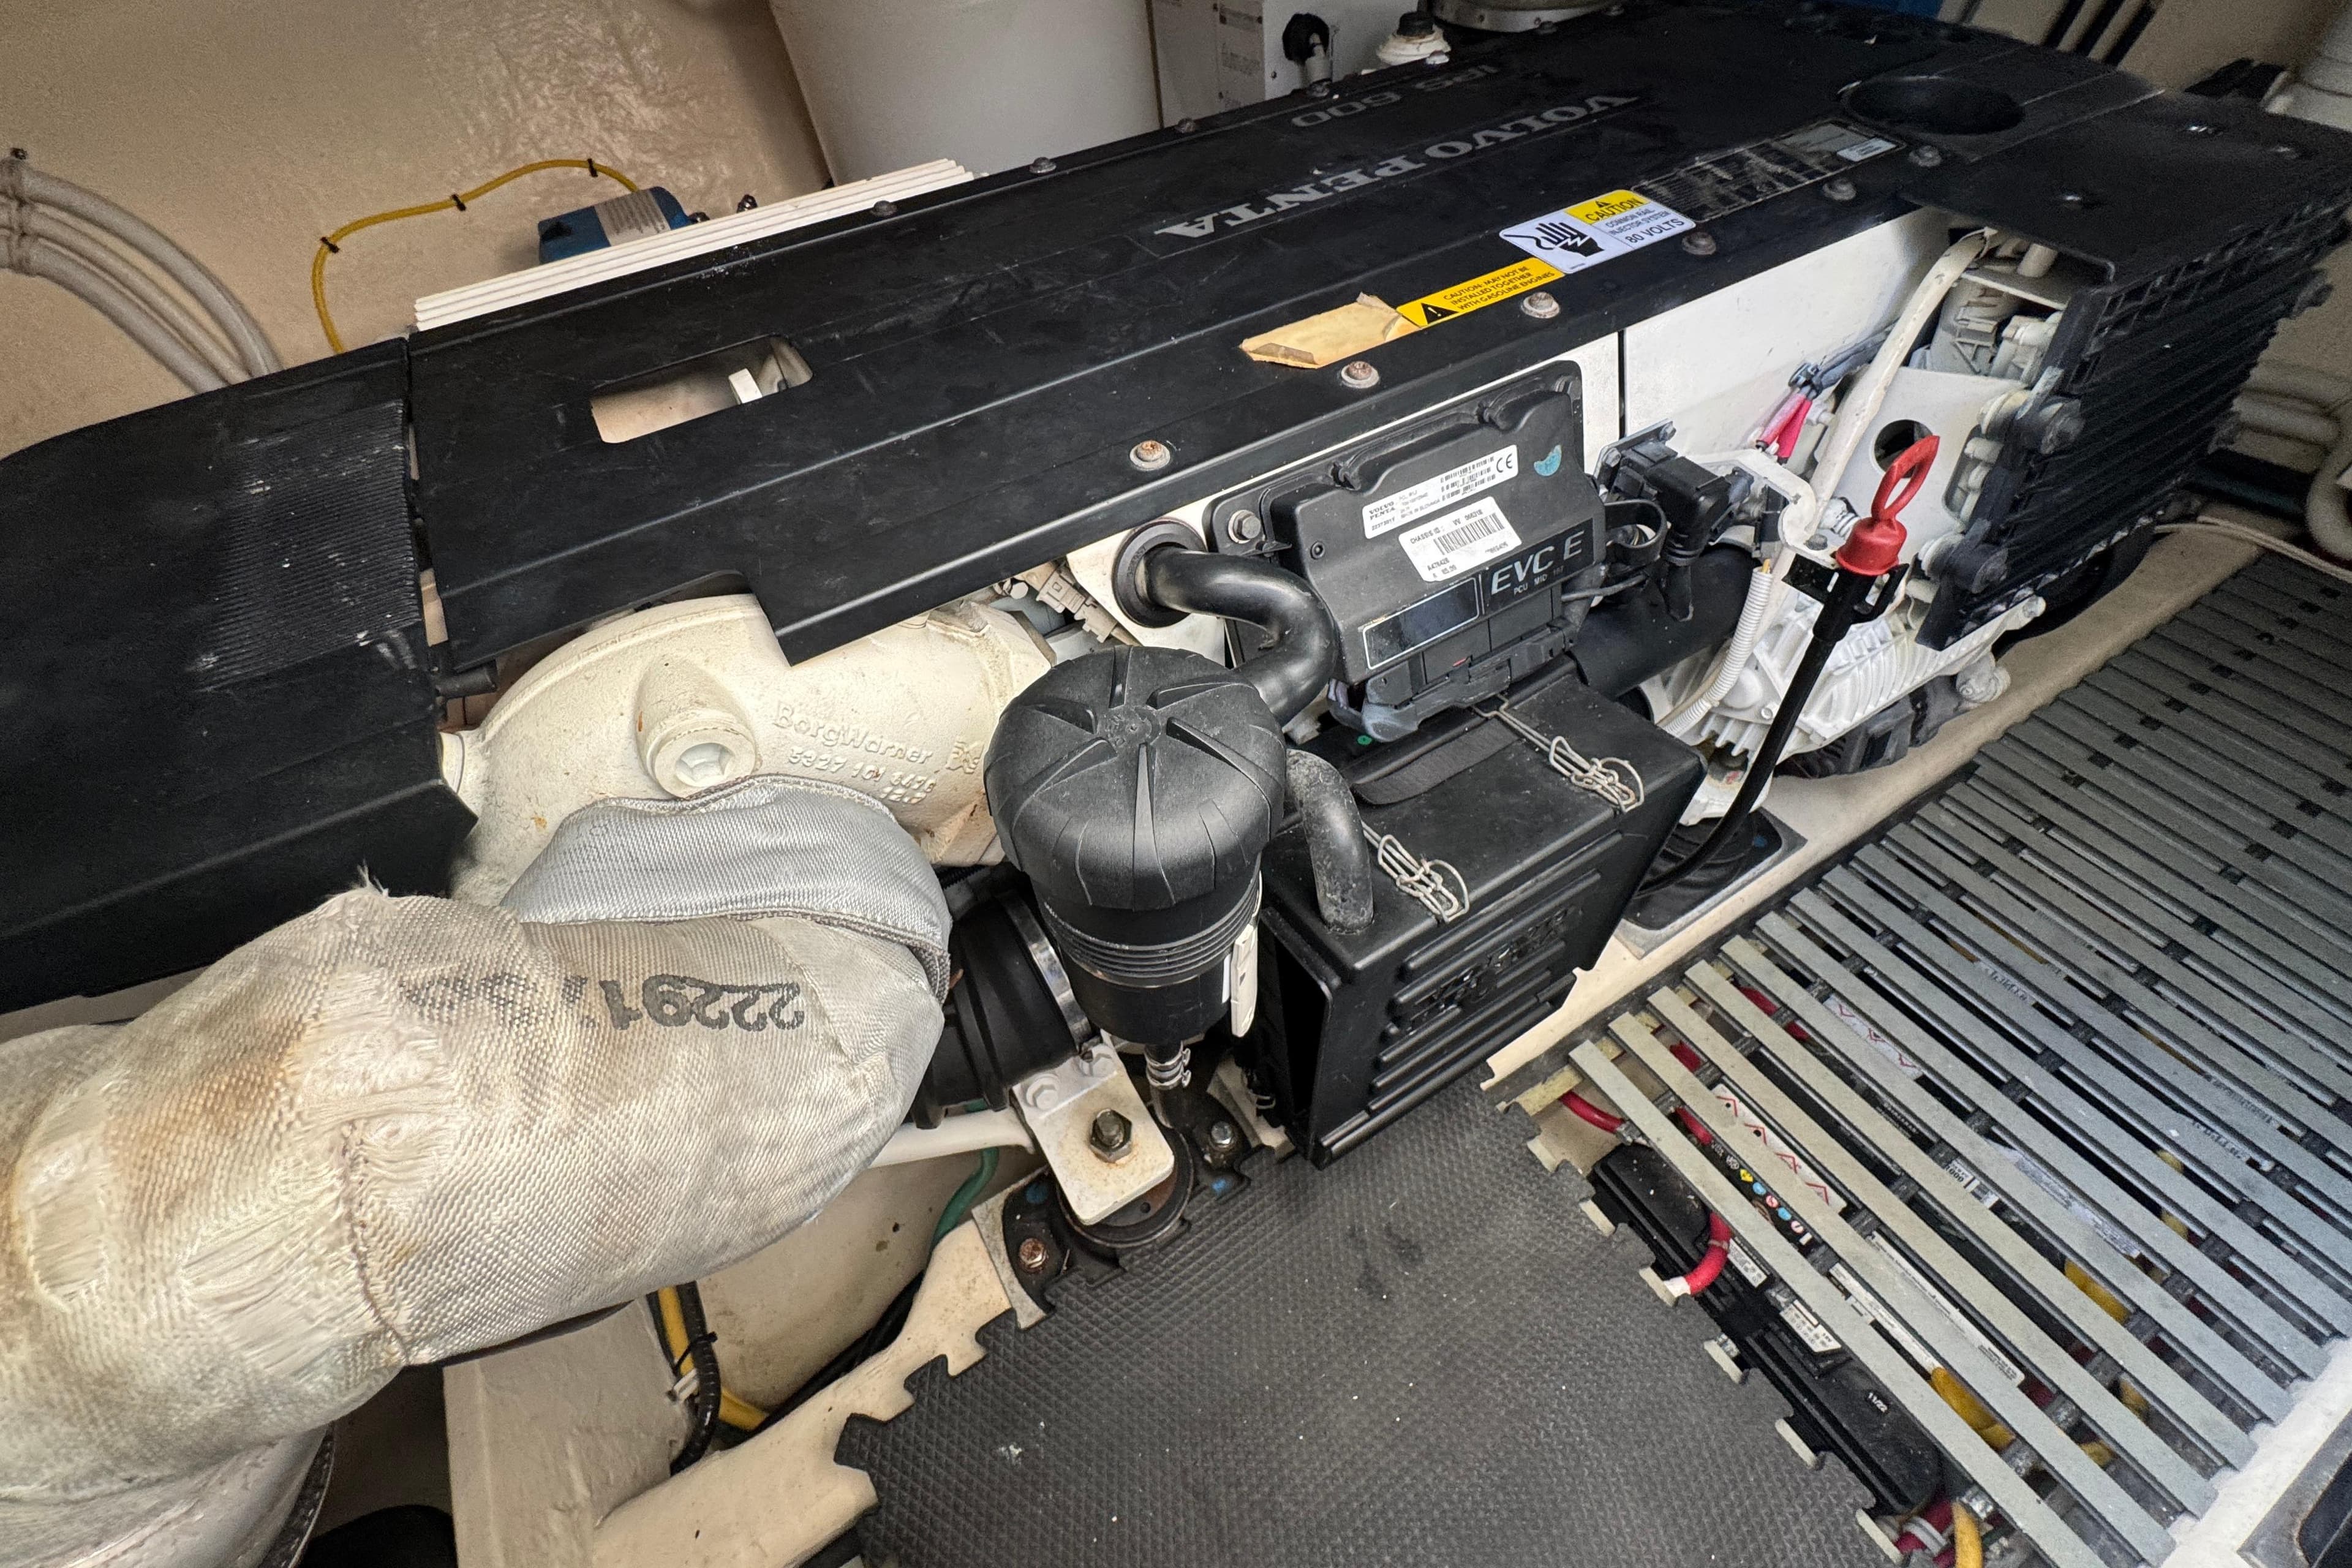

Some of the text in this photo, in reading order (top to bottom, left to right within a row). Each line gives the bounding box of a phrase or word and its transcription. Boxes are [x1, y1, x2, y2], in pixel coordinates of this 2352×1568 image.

[1291, 91, 1401, 127] 600
[1153, 95, 1640, 239] VOLVO PENTA
[1585, 198, 1643, 221] CAUTION
[1626, 218, 1685, 243] 80 VOLTS
[1451, 272, 1533, 305] INSTALLED TOGETHER
[1484, 276, 1501, 285] MAY
[1502, 270, 1518, 279] NOT
[1457, 298, 1480, 310] WITH
[1480, 284, 1521, 302] GASOLINE
[1369, 501, 1395, 515] VOLVO
[1370, 507, 1396, 521] PENTA
[1410, 530, 1433, 545] CHASSIS
[1491, 530, 1585, 595] EVC E
[1513, 582, 1528, 596] PCU
[1534, 573, 1548, 586] MID
[773, 701, 934, 765] BorgWarner
[789, 745, 848, 774] 5327
